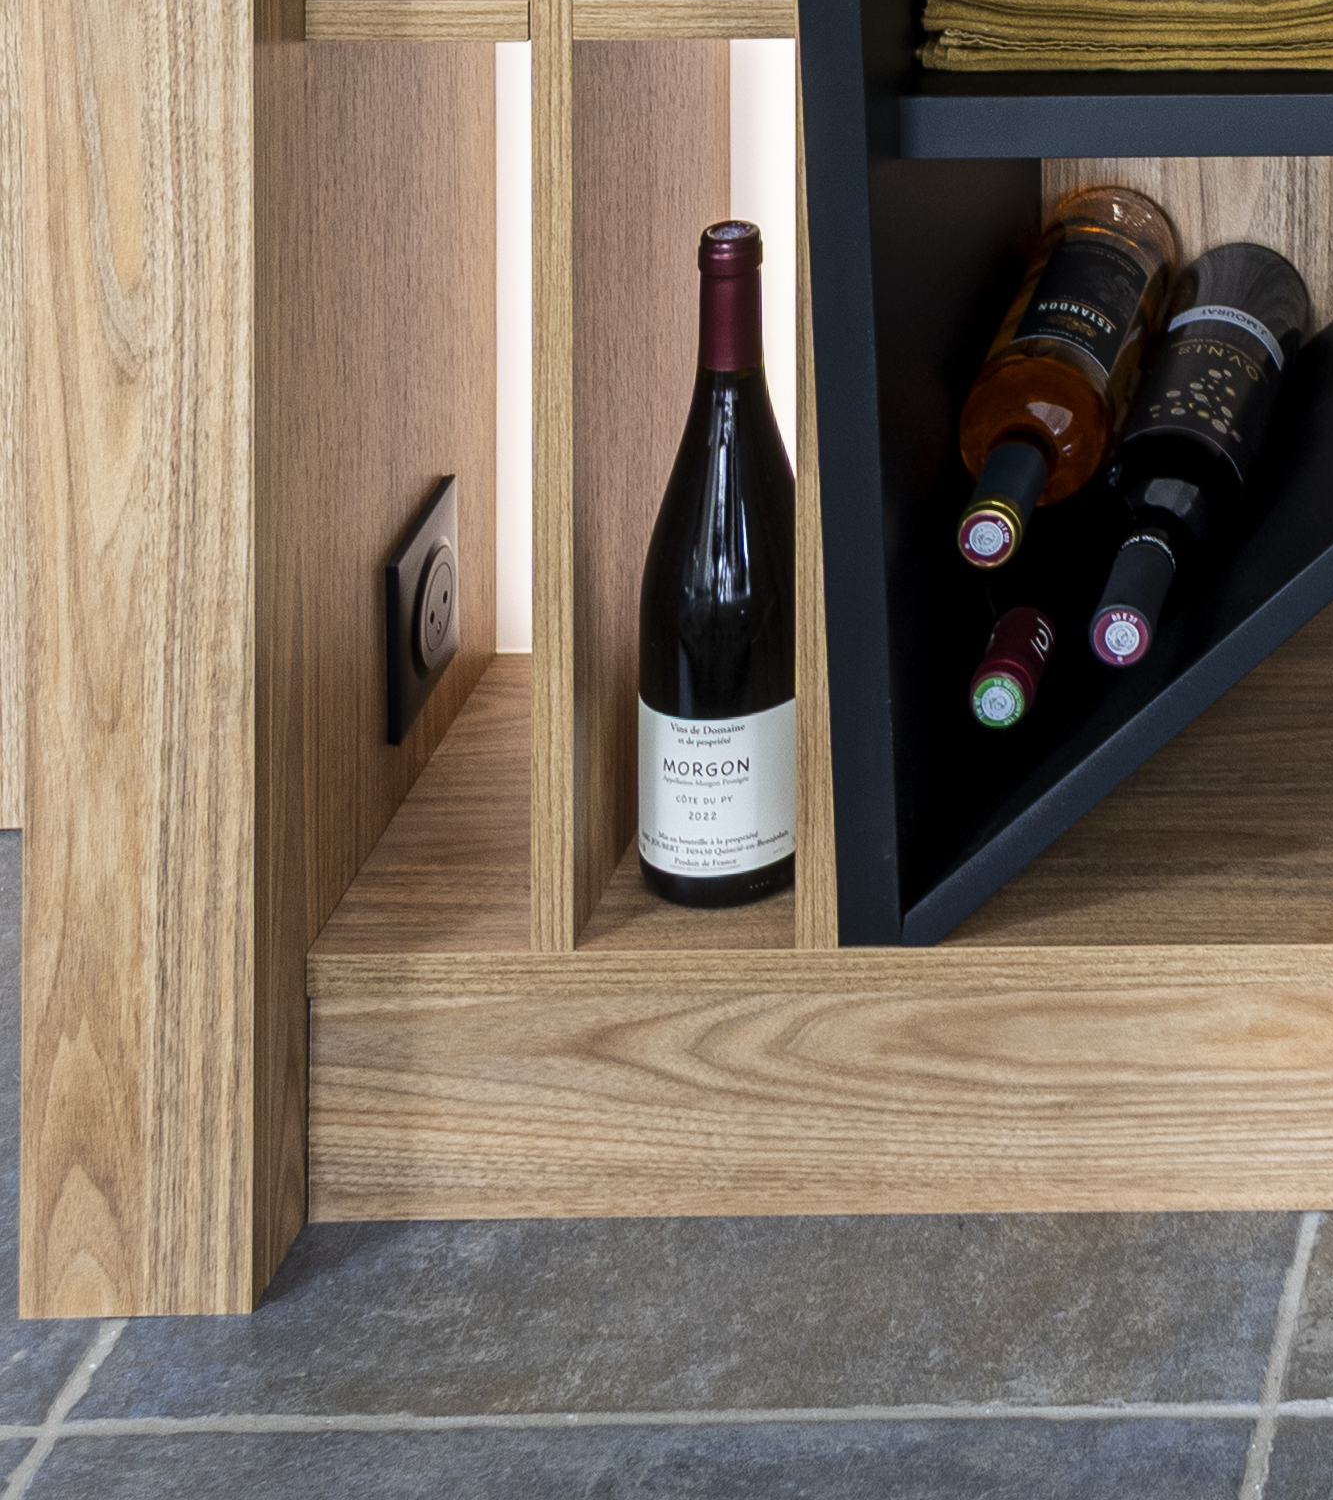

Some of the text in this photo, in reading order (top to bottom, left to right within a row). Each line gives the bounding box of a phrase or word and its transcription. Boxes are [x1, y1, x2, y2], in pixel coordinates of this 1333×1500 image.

[1038, 301, 1113, 335] ESTANDON
[670, 721, 746, 736] Vins de Domaine
[677, 736, 732, 748] et de propriété
[662, 756, 750, 778] MORGON
[676, 794, 699, 805] CÔTE
[703, 796, 716, 805] DU
[688, 811, 718, 821] 2022
[679, 835, 708, 846] bouteille
[716, 835, 724, 845] la
[673, 856, 738, 867] Produit de France
